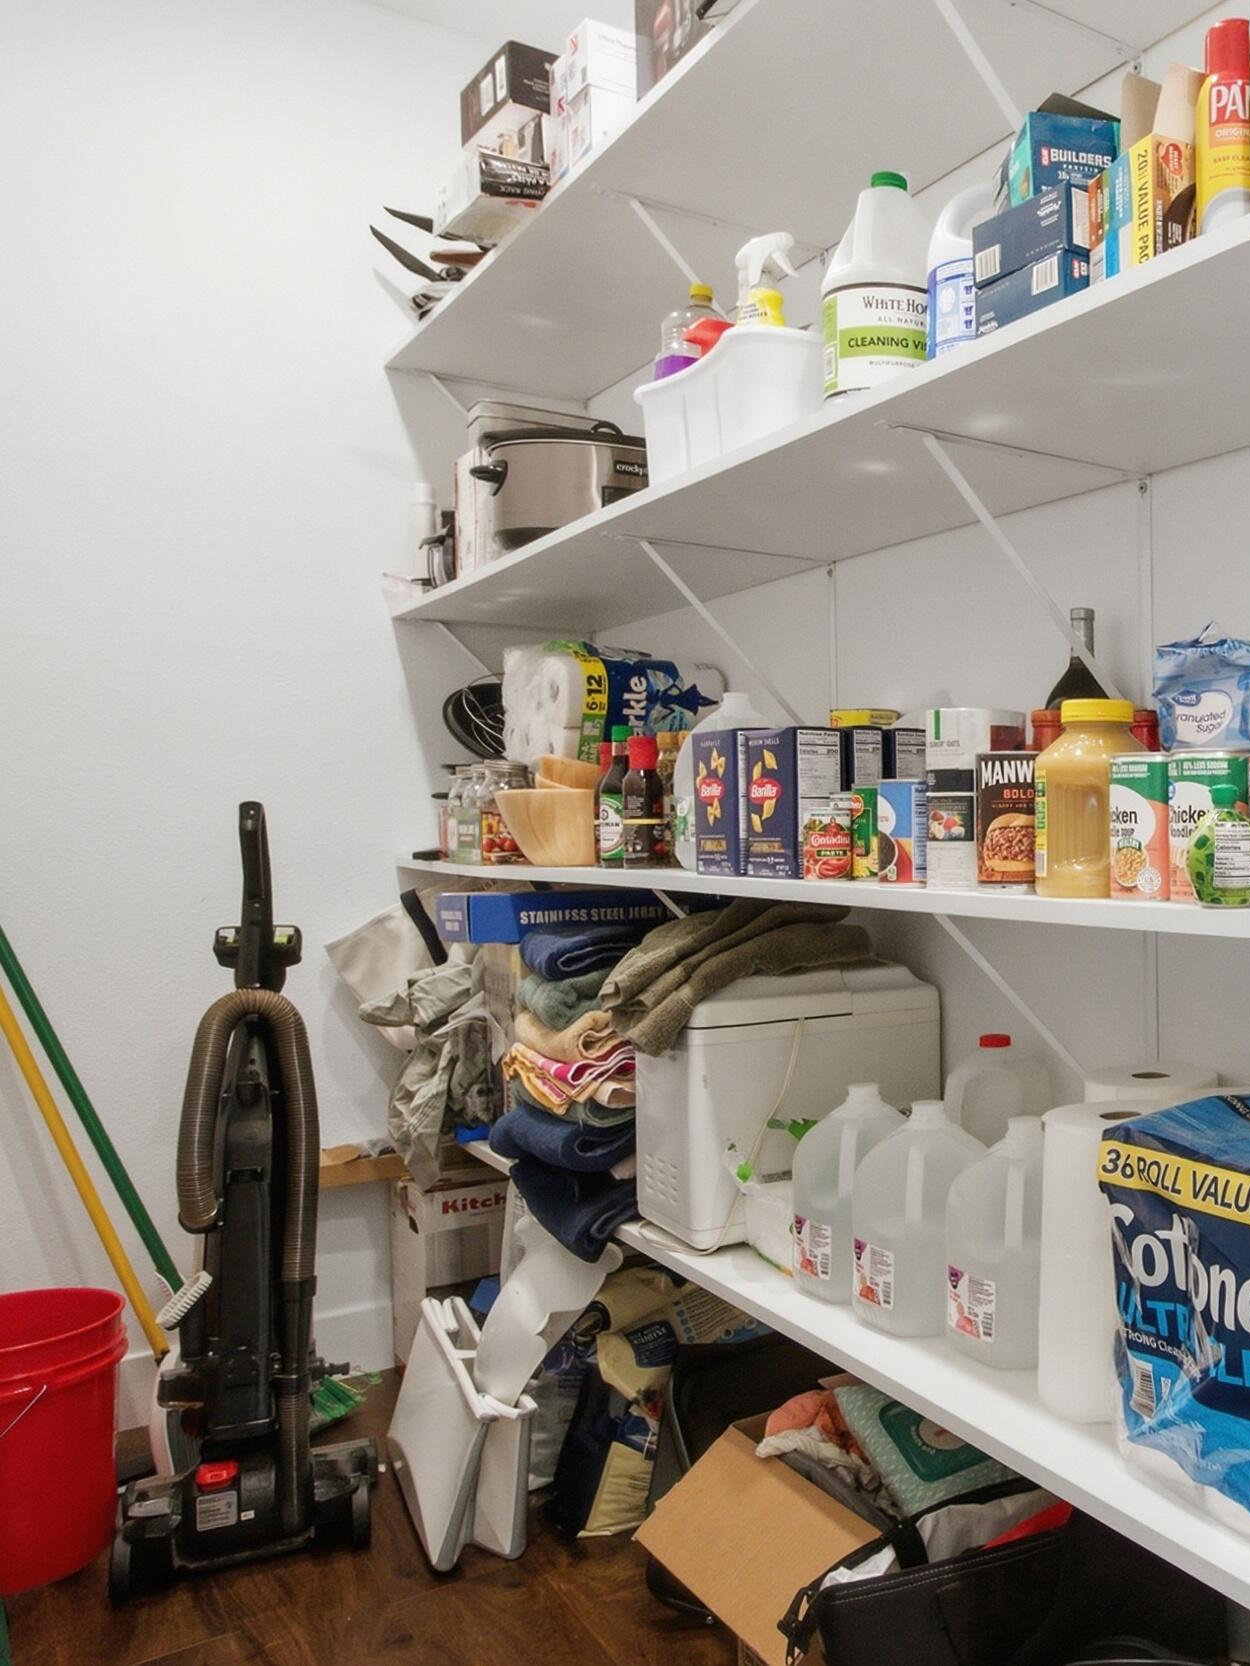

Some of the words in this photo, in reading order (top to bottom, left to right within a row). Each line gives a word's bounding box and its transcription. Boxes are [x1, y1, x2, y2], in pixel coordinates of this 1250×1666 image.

[1211, 83, 1249, 124] PA
[1050, 148, 1112, 169] BUILDERS
[1137, 180, 1149, 232] VALUE
[1138, 235, 1149, 264] PAC
[897, 317, 926, 327] NATUR
[848, 336, 909, 349] CLEANING
[586, 674, 603, 697] 12
[586, 701, 599, 711] 6
[1176, 709, 1227, 722] ranulated
[981, 760, 1034, 789] MANW
[1169, 804, 1209, 824] hicke
[520, 910, 589, 924] STAINLESS
[590, 908, 625, 921] STEEL
[1102, 1147, 1135, 1179] 36
[1136, 1154, 1182, 1196] ROLL
[441, 1193, 506, 1215] Kitch
